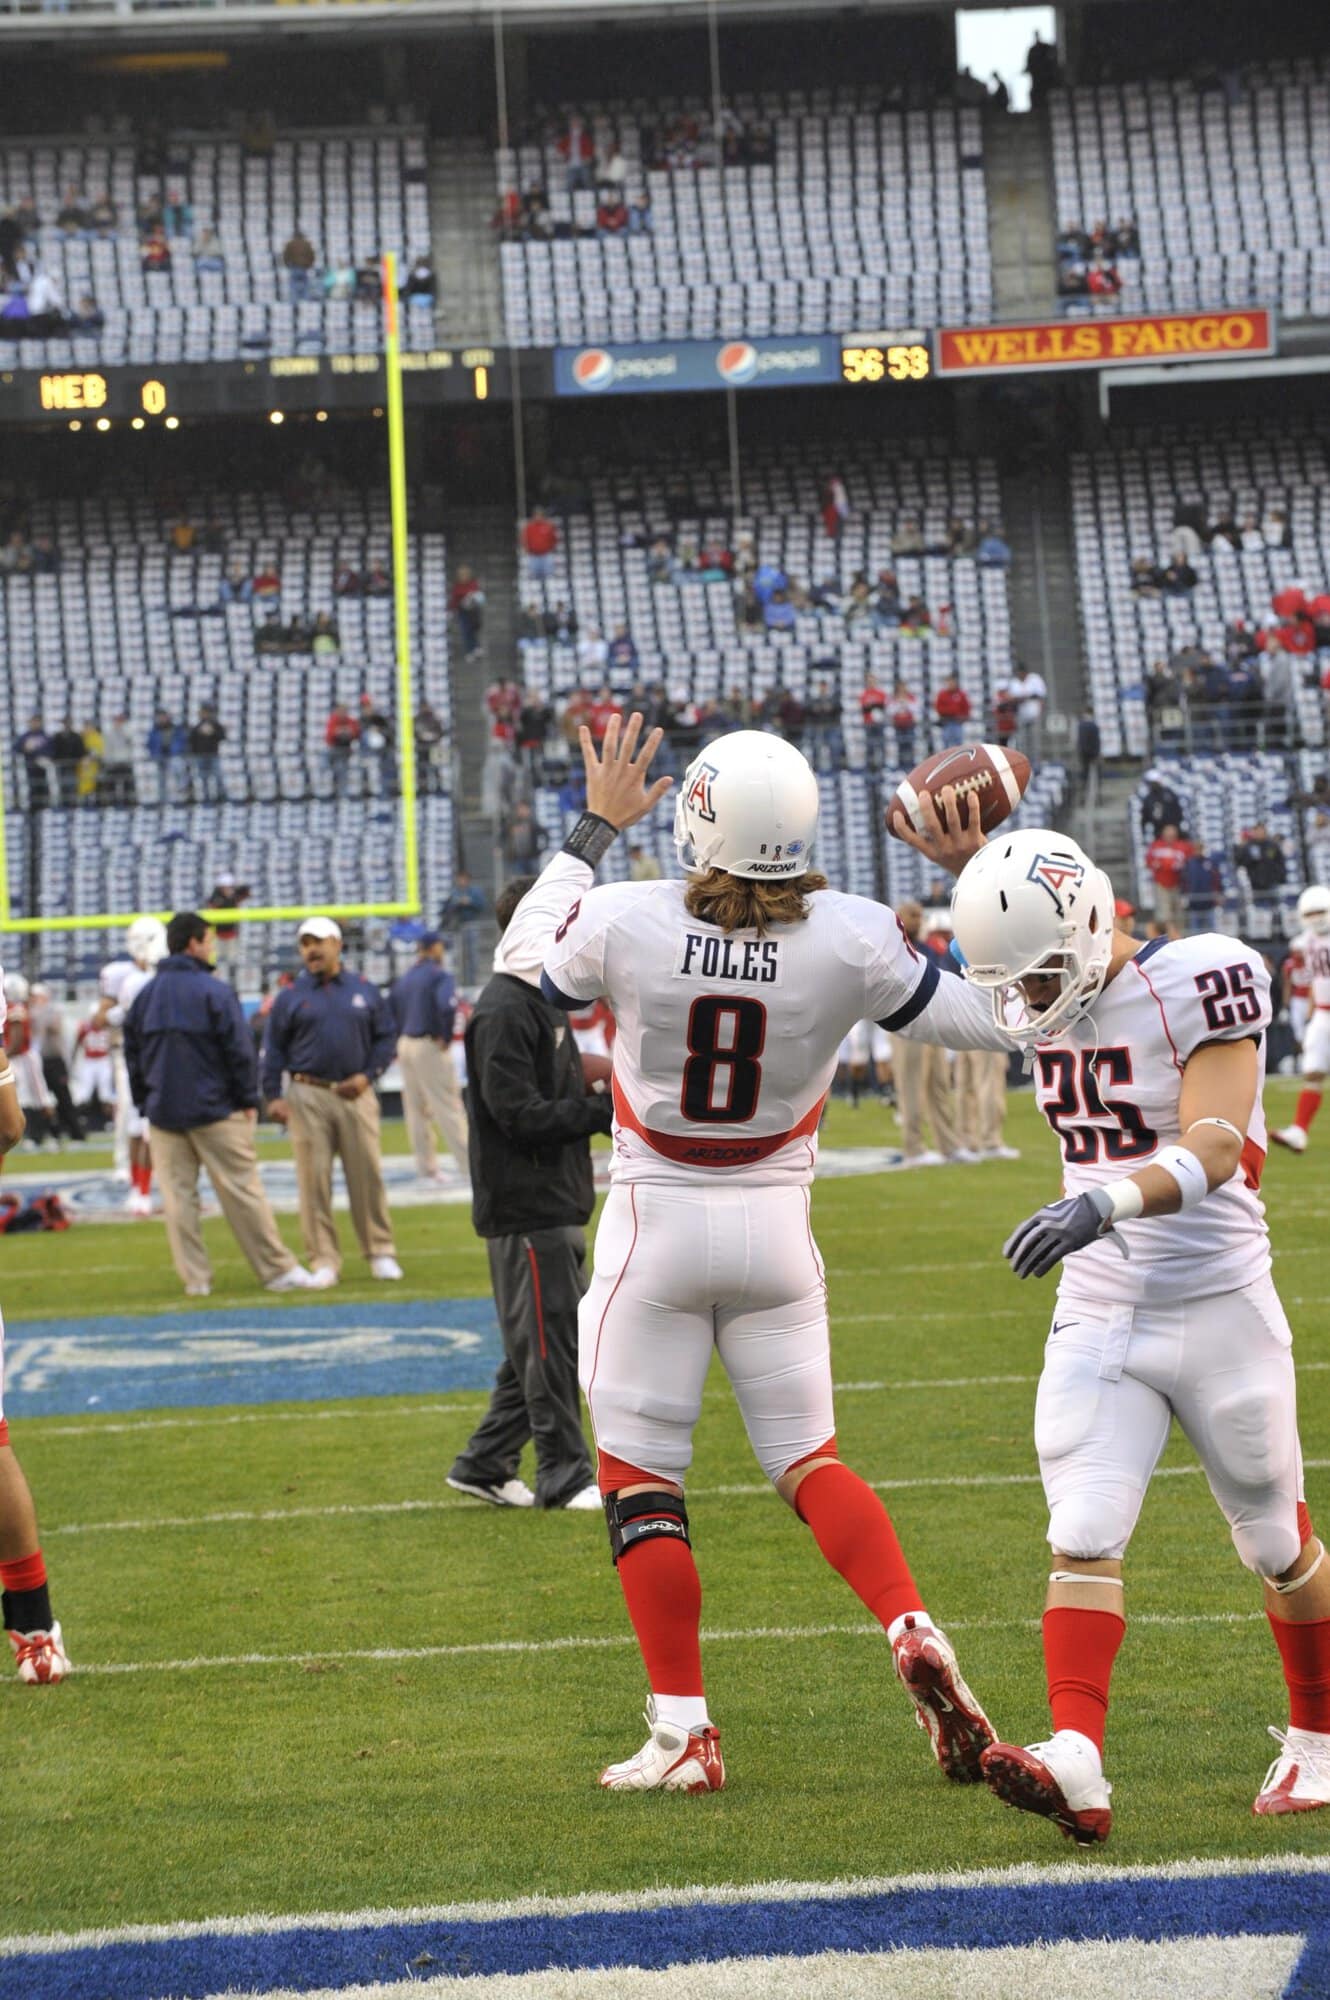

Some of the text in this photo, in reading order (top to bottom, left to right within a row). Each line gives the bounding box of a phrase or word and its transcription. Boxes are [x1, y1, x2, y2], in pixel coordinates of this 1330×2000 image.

[842, 347, 884, 382] 56
[954, 315, 1255, 366] WELLS FARGO
[142, 379, 166, 415] 0
[746, 862, 797, 873] ARIZONA
[681, 934, 778, 982] FOLES
[1193, 962, 1262, 1031] 25
[680, 994, 767, 1124] 8
[1036, 1046, 1158, 1165] 25
[682, 1146, 760, 1160] ARIZONA
